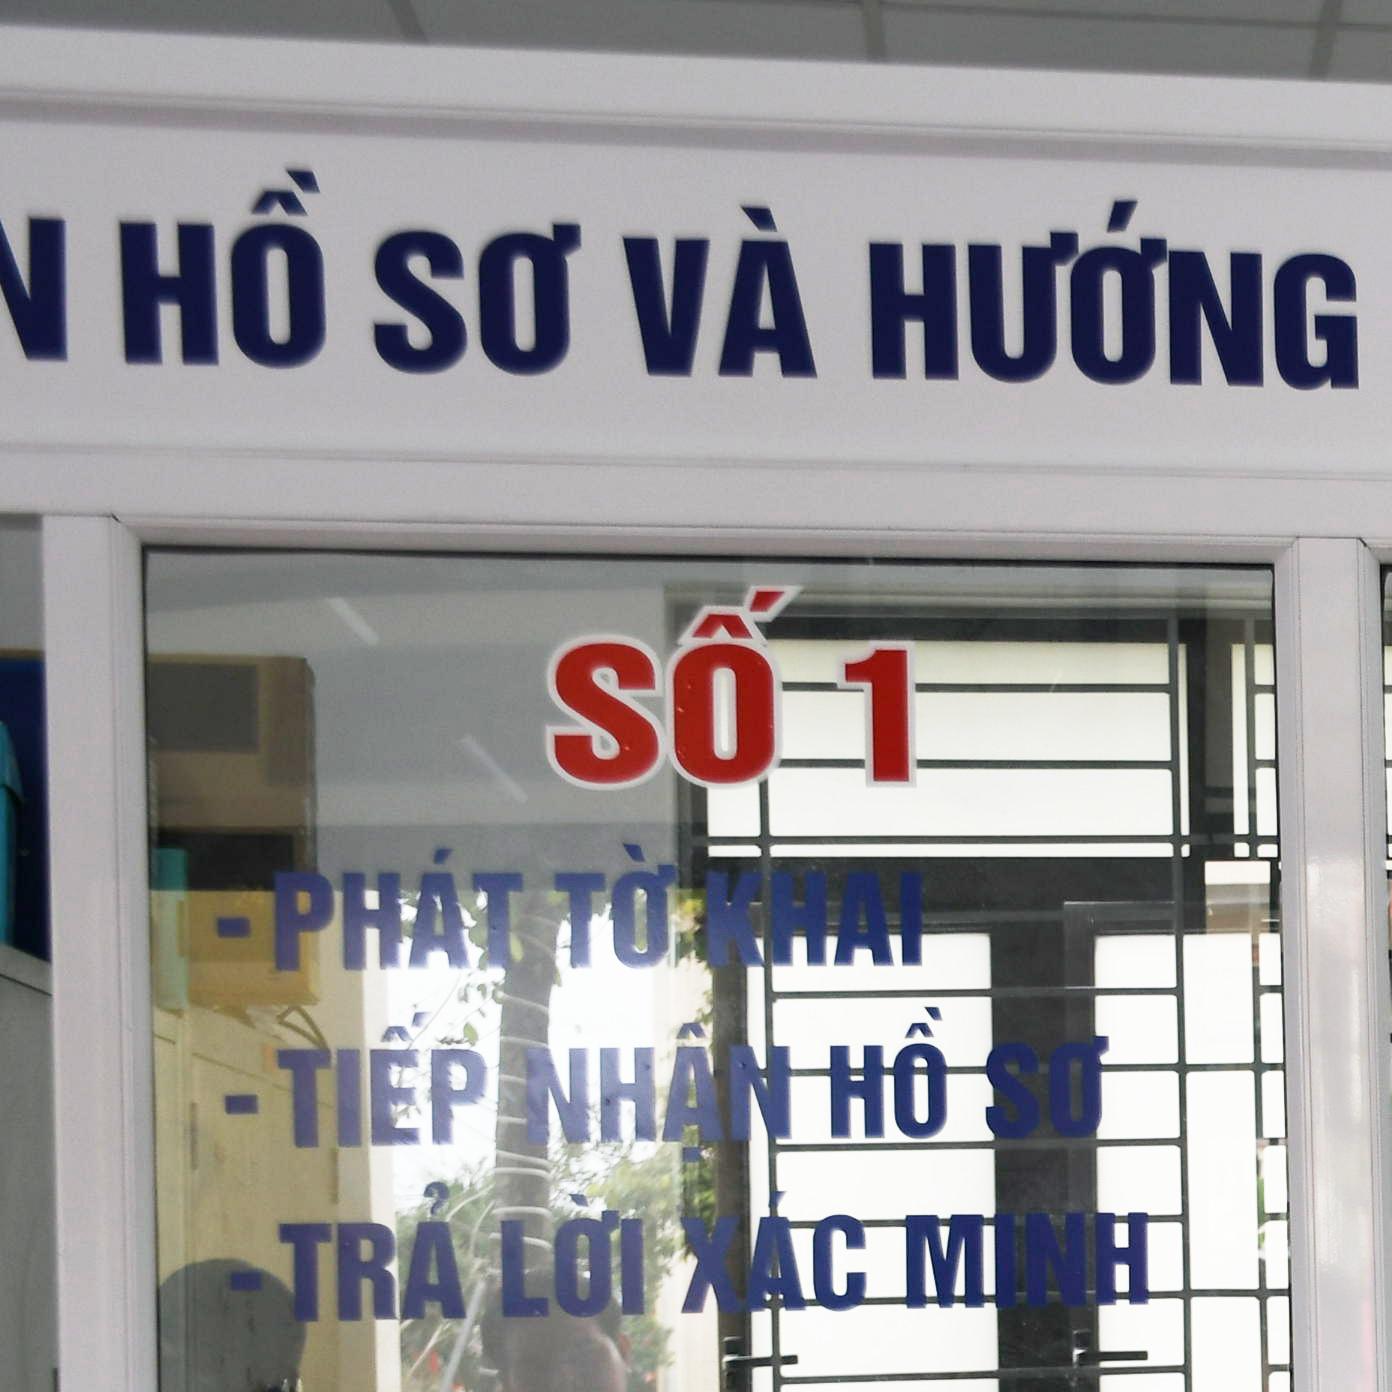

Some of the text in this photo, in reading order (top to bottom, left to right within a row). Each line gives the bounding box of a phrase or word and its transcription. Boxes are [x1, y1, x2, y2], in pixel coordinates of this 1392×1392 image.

[119, 168, 327, 369] HỒ
[373, 223, 582, 376] SƠ
[622, 205, 818, 379] VÀ
[869, 200, 1359, 390] HƯỚNG
[549, 586, 915, 787] SỐ 1
[274, 848, 522, 971] PHÁT
[555, 843, 676, 968] TỜ
[707, 871, 923, 967] KHAI
[277, 1012, 485, 1148] TIẾP
[525, 1021, 791, 1161] NHẬN
[829, 1006, 947, 1139] HỒ
[986, 1035, 1108, 1139] SƠ
[279, 1181, 466, 1322] TRẢ
[502, 1194, 645, 1319] LỜI
[681, 1191, 866, 1313] XÁC
[904, 1211, 1149, 1308] MINH
